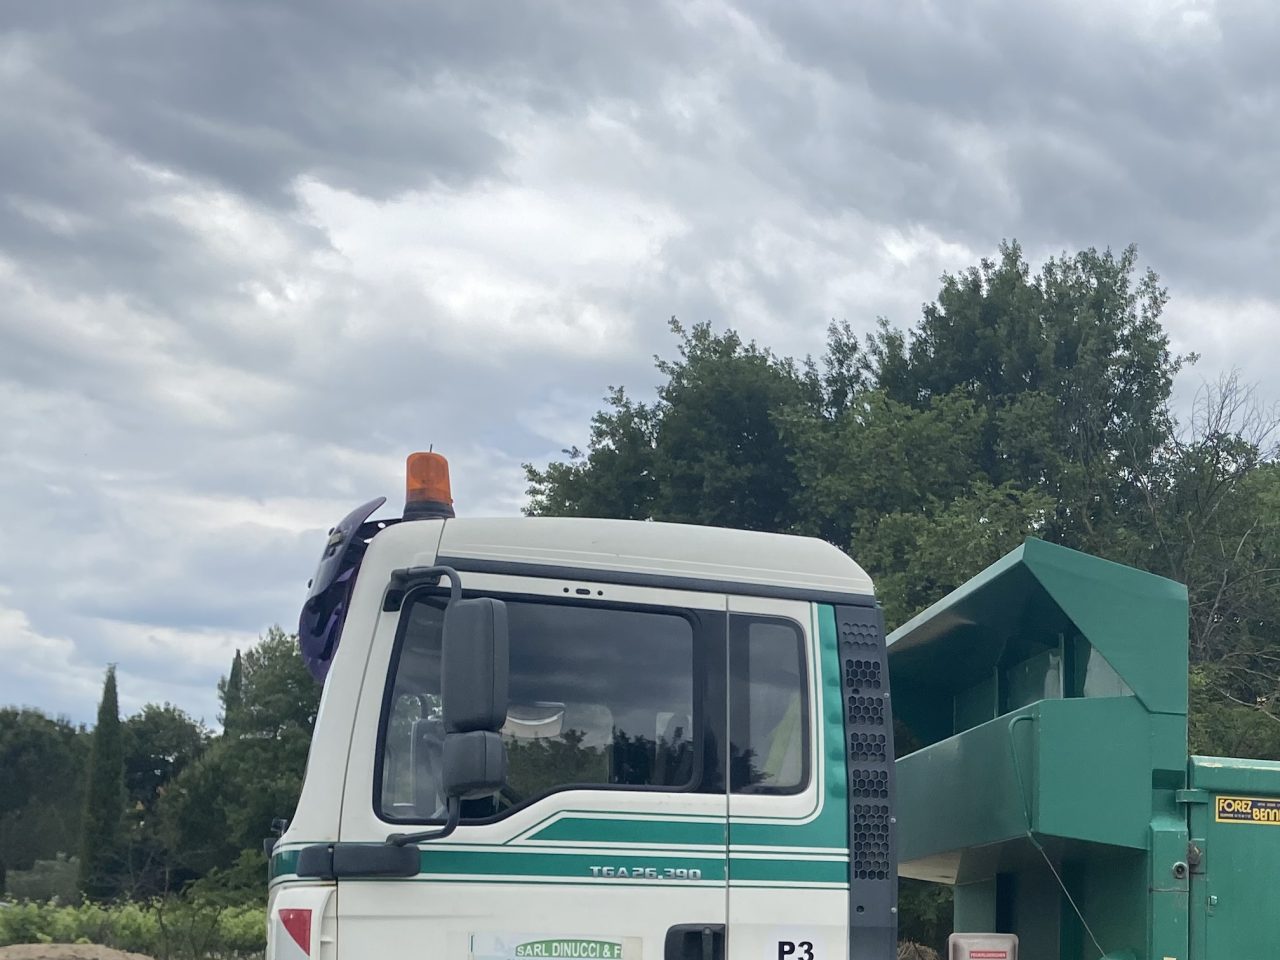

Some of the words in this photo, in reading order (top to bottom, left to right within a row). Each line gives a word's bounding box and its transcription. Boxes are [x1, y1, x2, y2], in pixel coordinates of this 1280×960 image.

[1219, 799, 1252, 813] FOREZ
[590, 866, 629, 879] TGA
[632, 867, 702, 880] 26.390
[517, 944, 549, 957] SARL
[552, 943, 600, 958] DINUCCI
